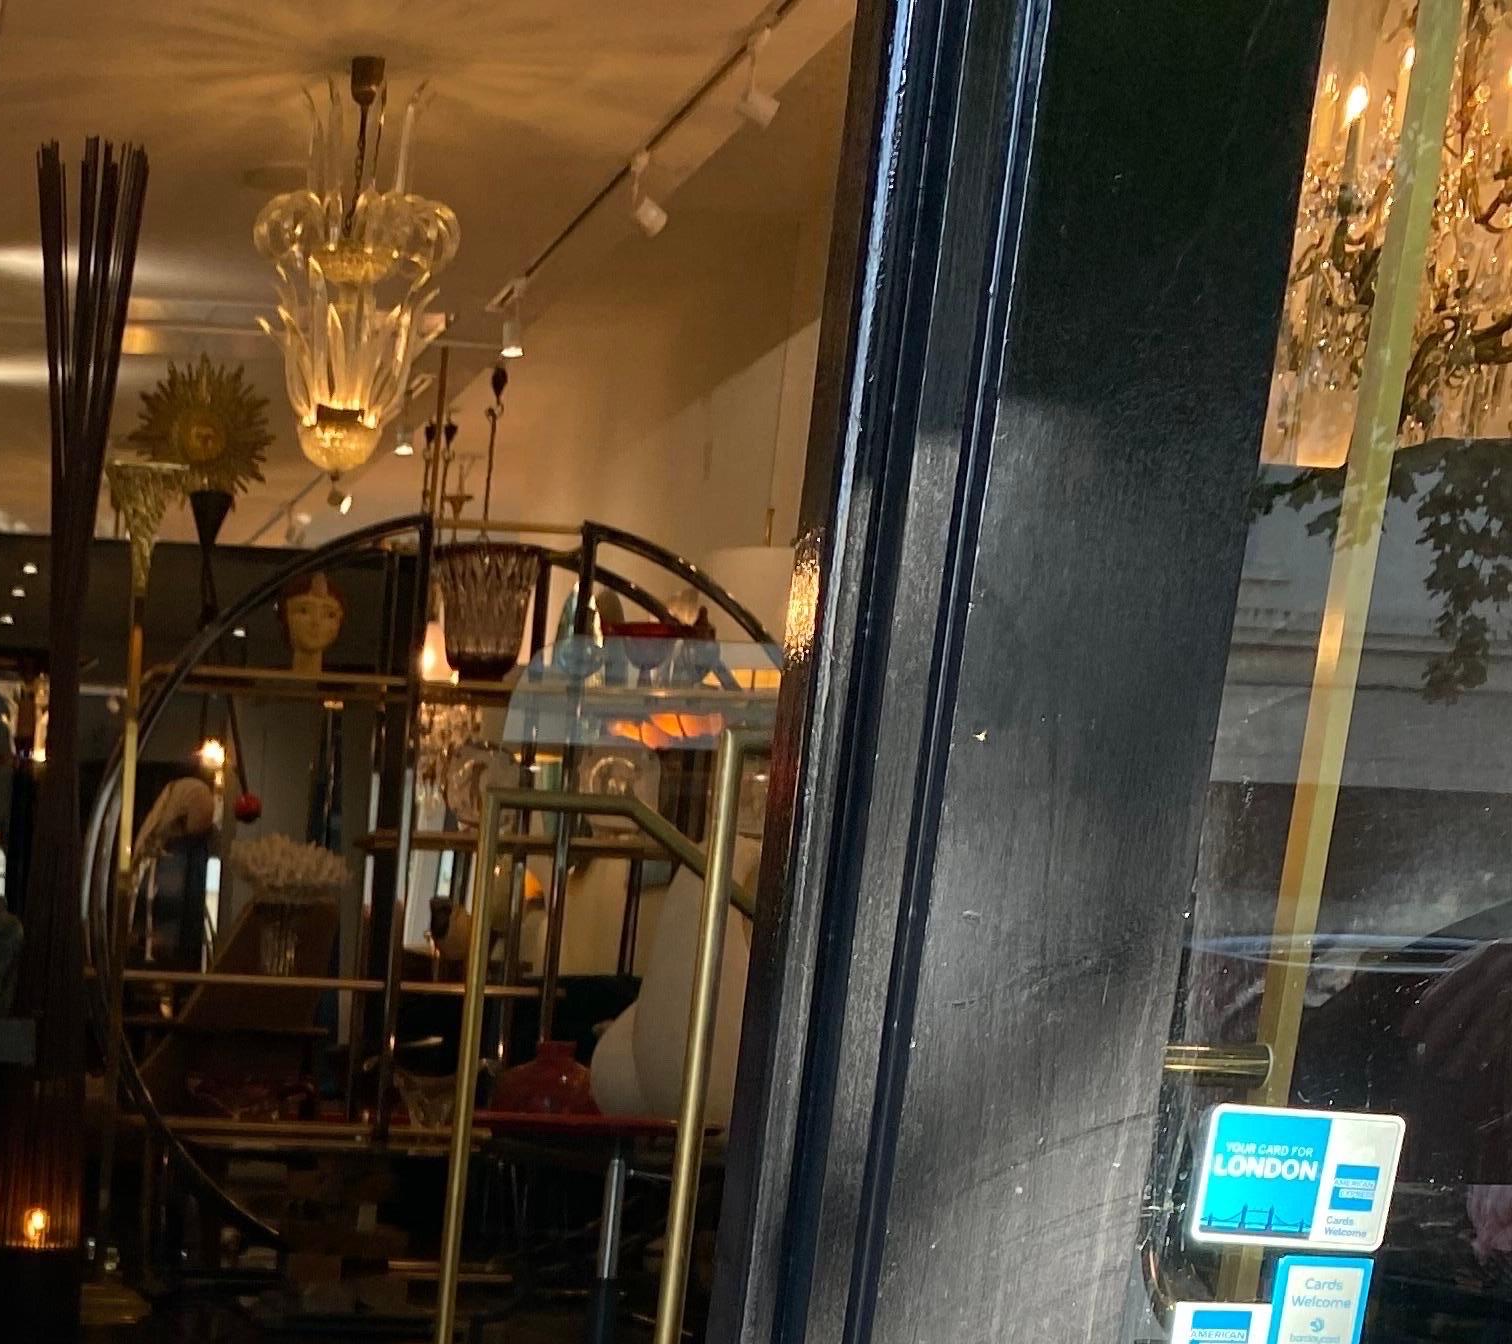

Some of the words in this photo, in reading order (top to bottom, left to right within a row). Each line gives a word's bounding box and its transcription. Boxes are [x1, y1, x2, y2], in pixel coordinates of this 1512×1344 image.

[1226, 1141, 1256, 1154] YOUR
[1259, 1143, 1289, 1157] CARD
[1291, 1146, 1314, 1158] FOR
[1214, 1154, 1318, 1181] LONDON
[1326, 1215, 1354, 1226] Cards
[1324, 1227, 1367, 1238] Welcome
[1304, 1277, 1344, 1291] Cards
[1291, 1295, 1352, 1309] Welcome
[1190, 1329, 1246, 1341] AMERICAN
